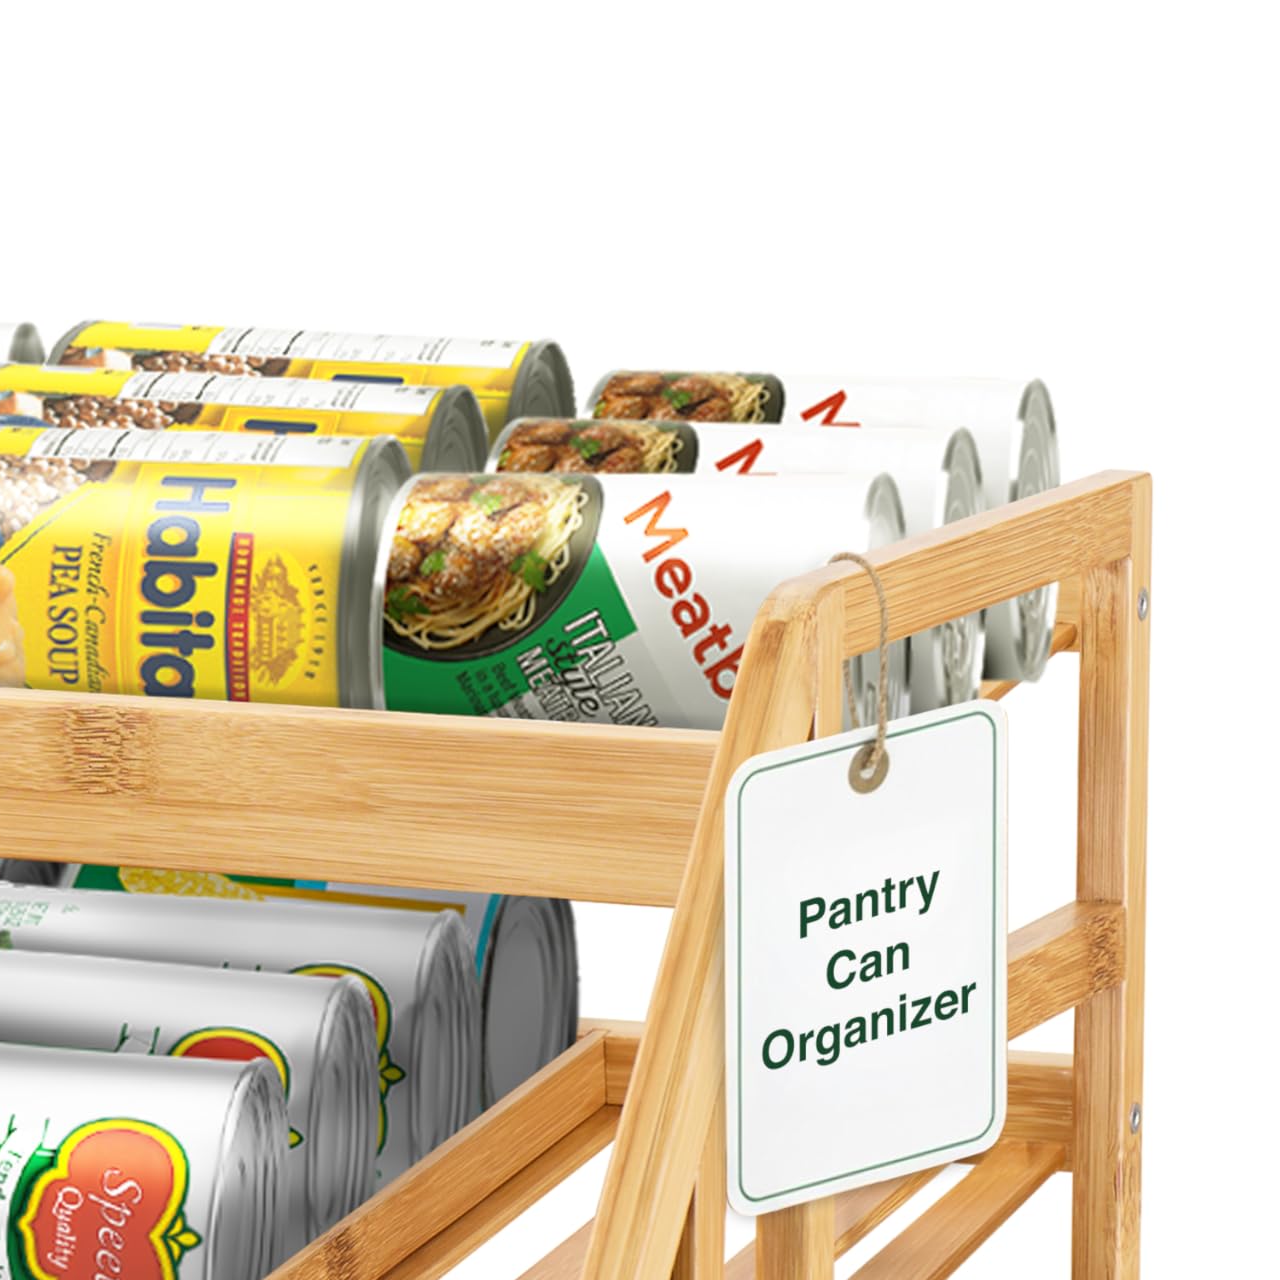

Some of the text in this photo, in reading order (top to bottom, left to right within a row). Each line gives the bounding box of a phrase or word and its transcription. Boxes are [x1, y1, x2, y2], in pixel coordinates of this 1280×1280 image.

[46, 544, 83, 685] PEA SOUP
[140, 475, 237, 698] Habita
[544, 637, 600, 718] style
[800, 870, 940, 939] Pantry
[826, 941, 910, 990] Can
[762, 982, 976, 1070] Organizer
[47, 1185, 84, 1270] Quality
